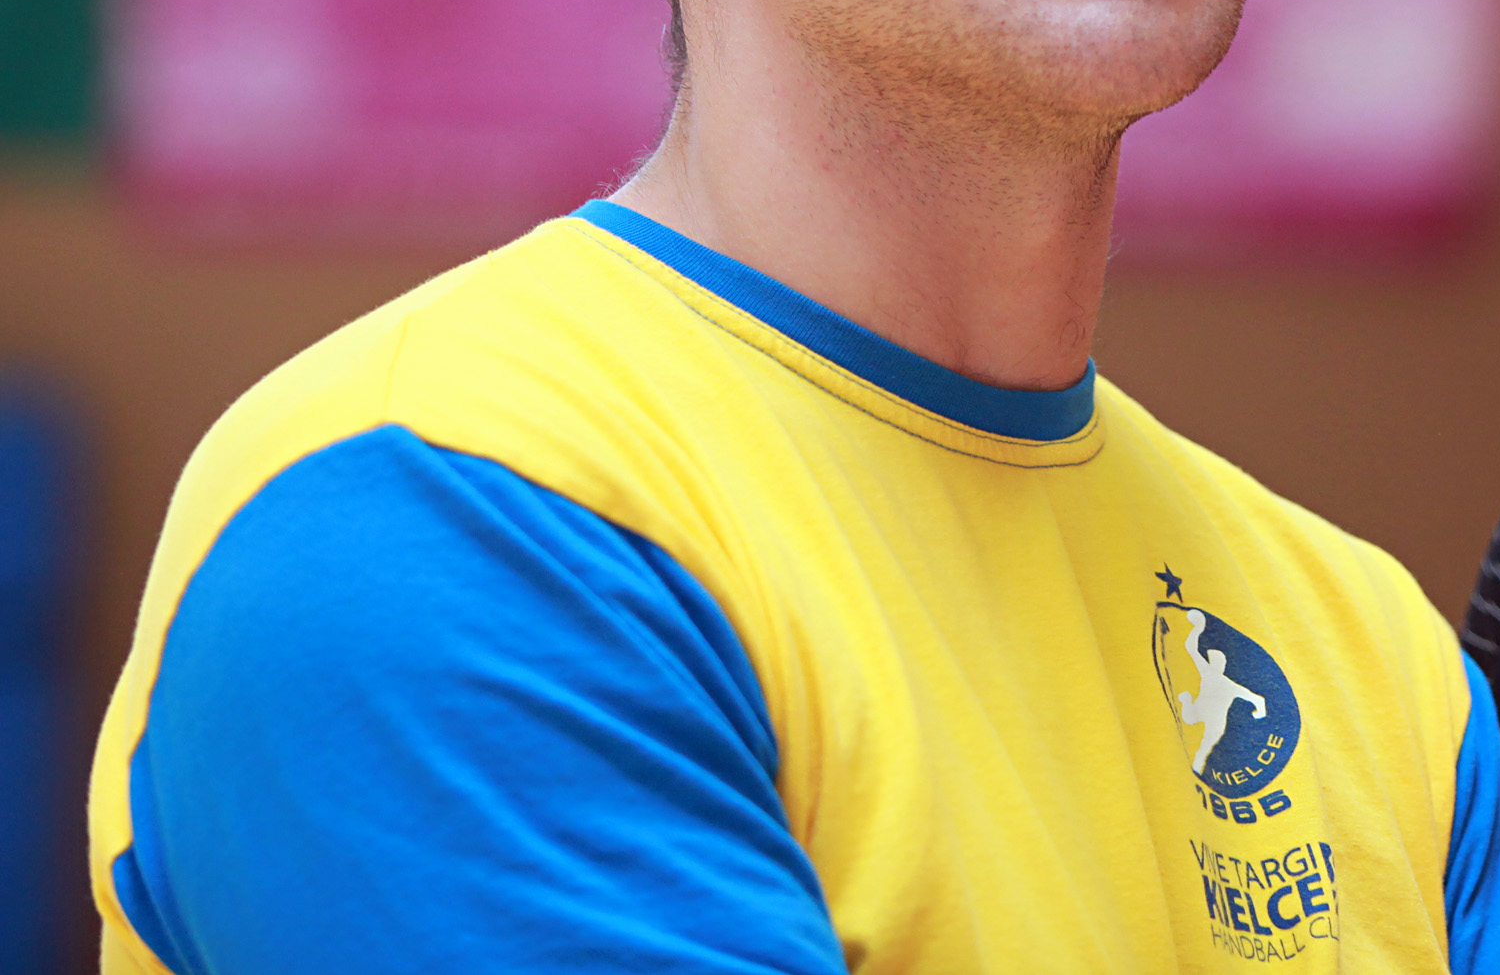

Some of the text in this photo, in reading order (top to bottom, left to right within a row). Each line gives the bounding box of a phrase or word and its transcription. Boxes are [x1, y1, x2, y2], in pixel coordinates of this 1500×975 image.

[1212, 734, 1284, 785] KIELCE
[1195, 784, 1292, 824] 1965
[1229, 843, 1317, 889] TARGI
[1202, 873, 1330, 936] KIELCE
[1211, 923, 1305, 963] HANDBALL
